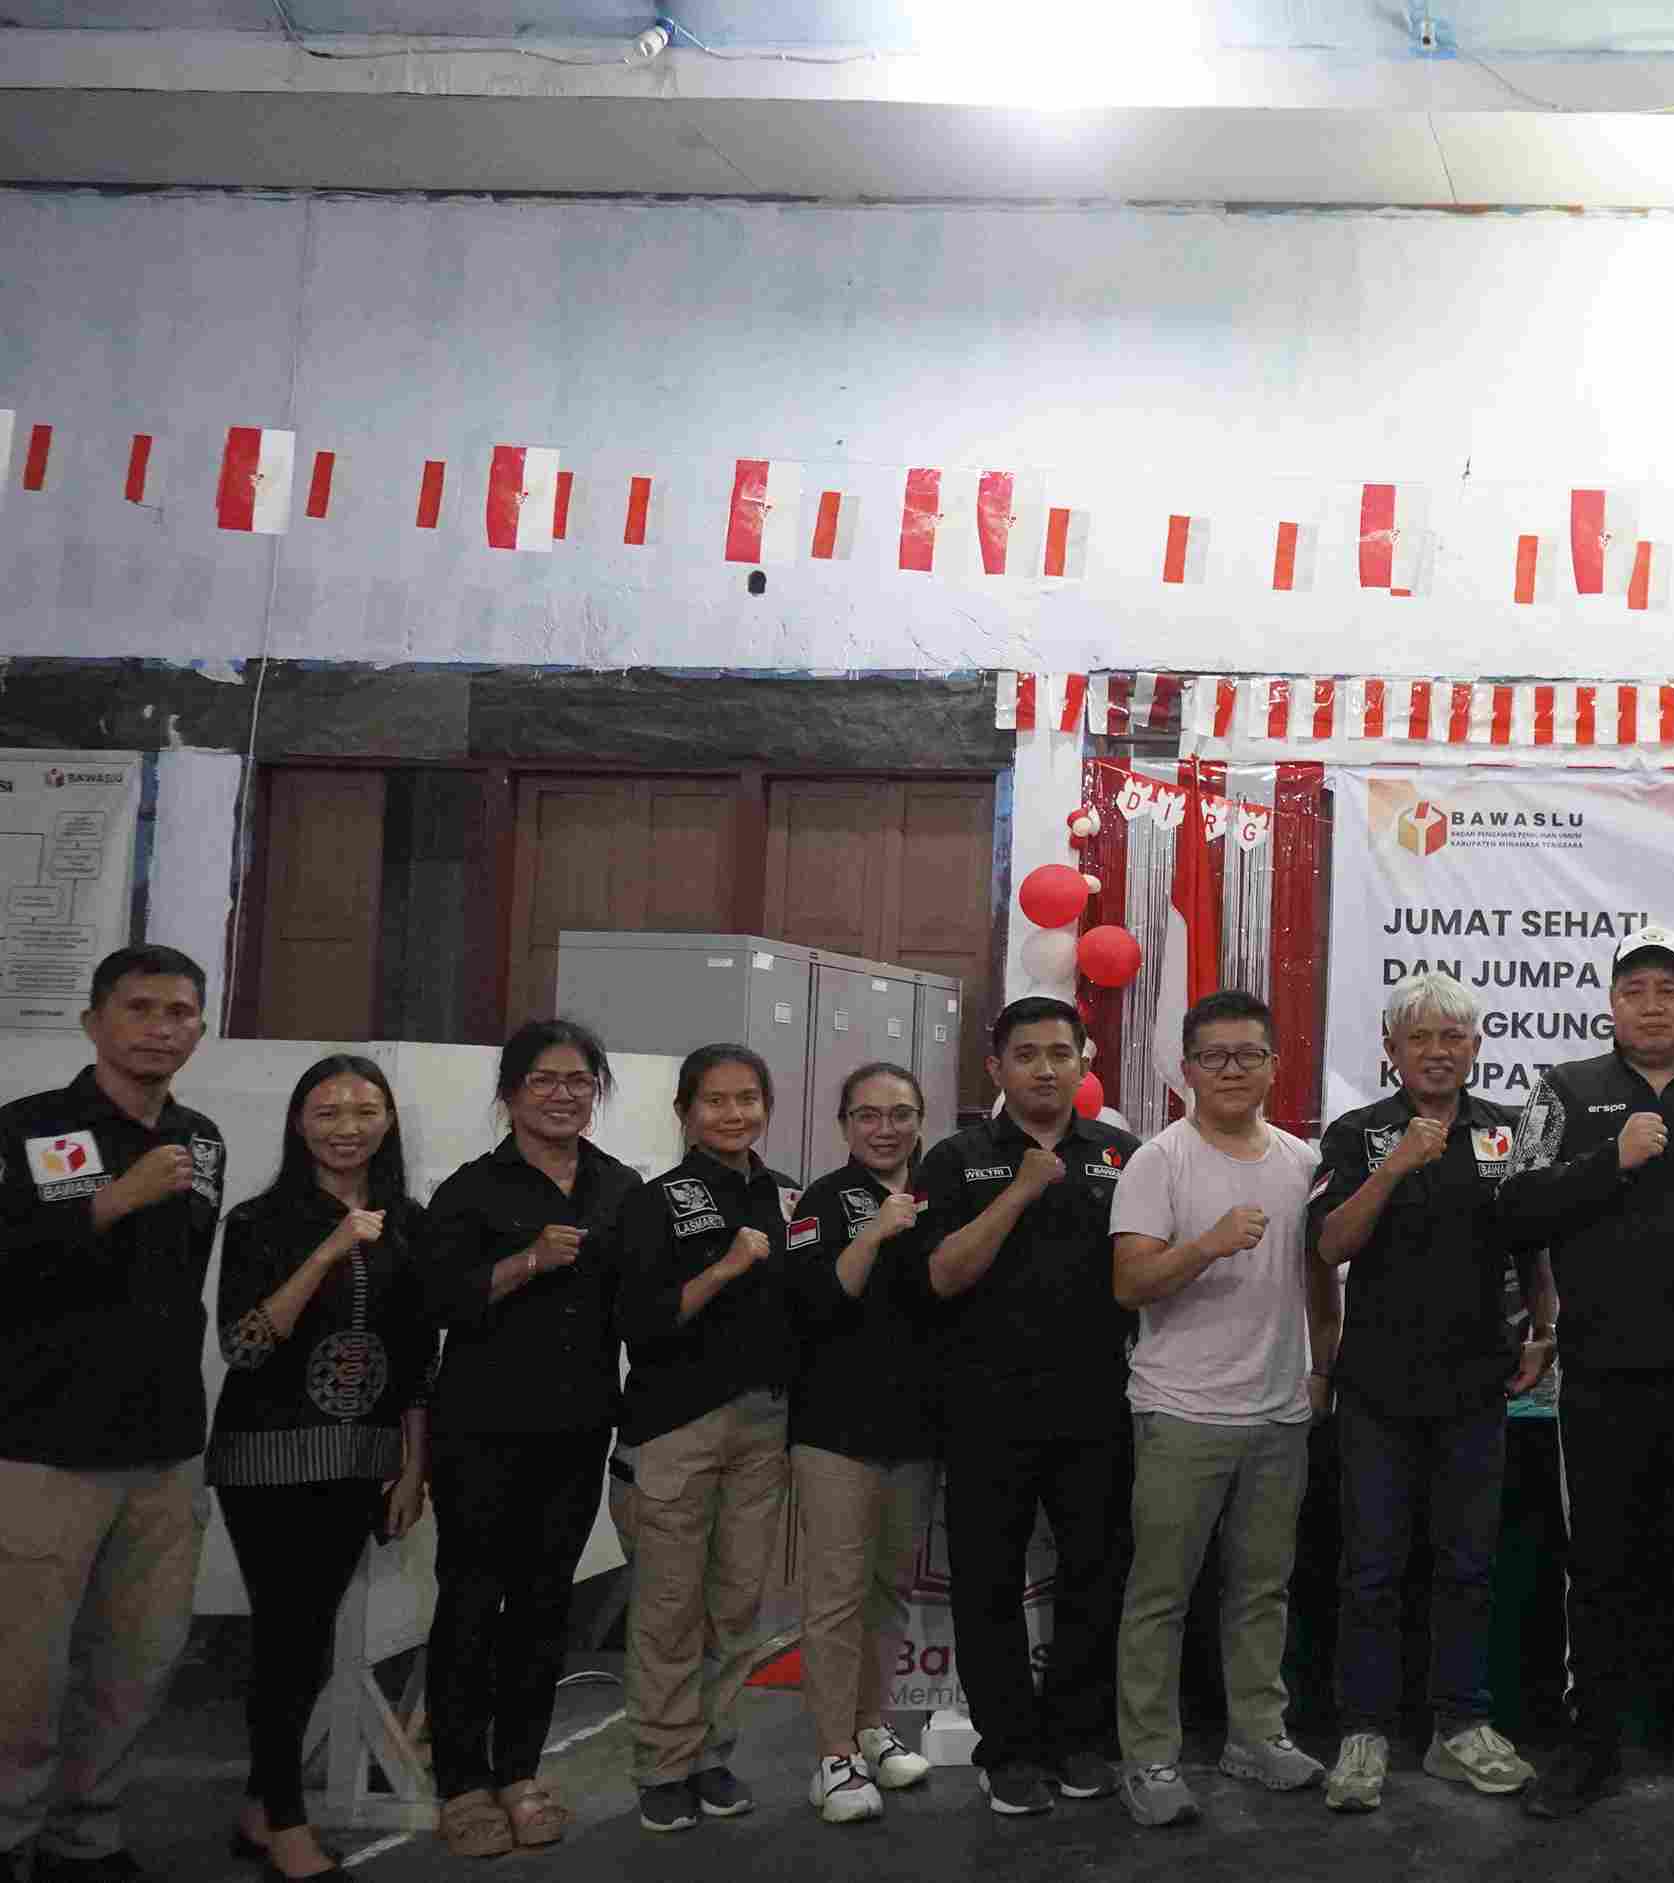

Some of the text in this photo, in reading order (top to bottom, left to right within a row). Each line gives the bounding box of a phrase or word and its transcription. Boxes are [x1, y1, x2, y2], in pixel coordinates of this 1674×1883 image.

[1451, 811, 1584, 828] BAWASLU
[1383, 907, 1513, 937] JUMAT
[1383, 958, 1601, 989] DAN JUMPA
[1482, 1011, 1616, 1041] GKUNG
[1379, 1060, 1556, 1090] KUPAT
[1588, 1103, 1627, 1114] erspo
